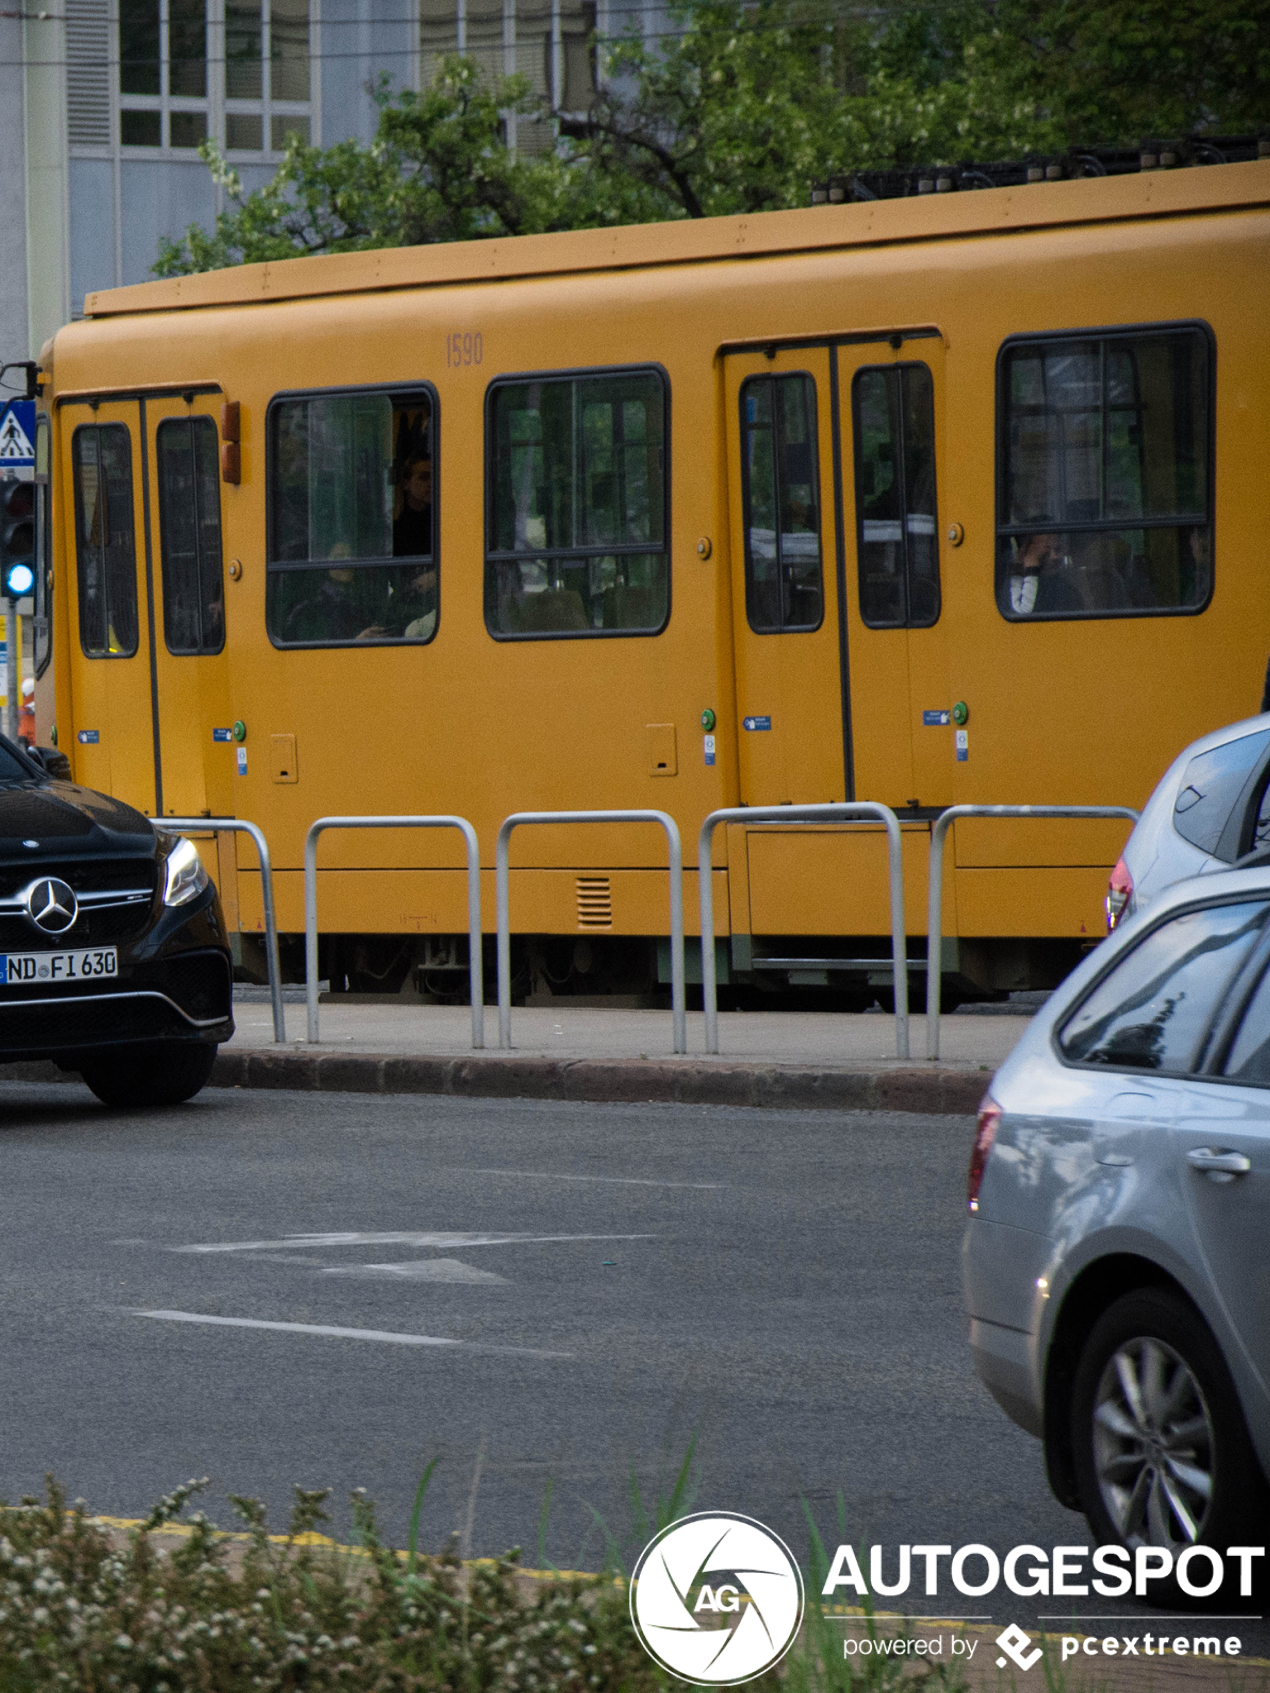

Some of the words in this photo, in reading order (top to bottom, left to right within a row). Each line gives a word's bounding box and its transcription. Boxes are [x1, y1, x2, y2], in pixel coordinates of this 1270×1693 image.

[445, 332, 483, 368] 1590
[8, 958, 37, 980] ND
[51, 955, 76, 978] FI
[81, 951, 116, 976] 630
